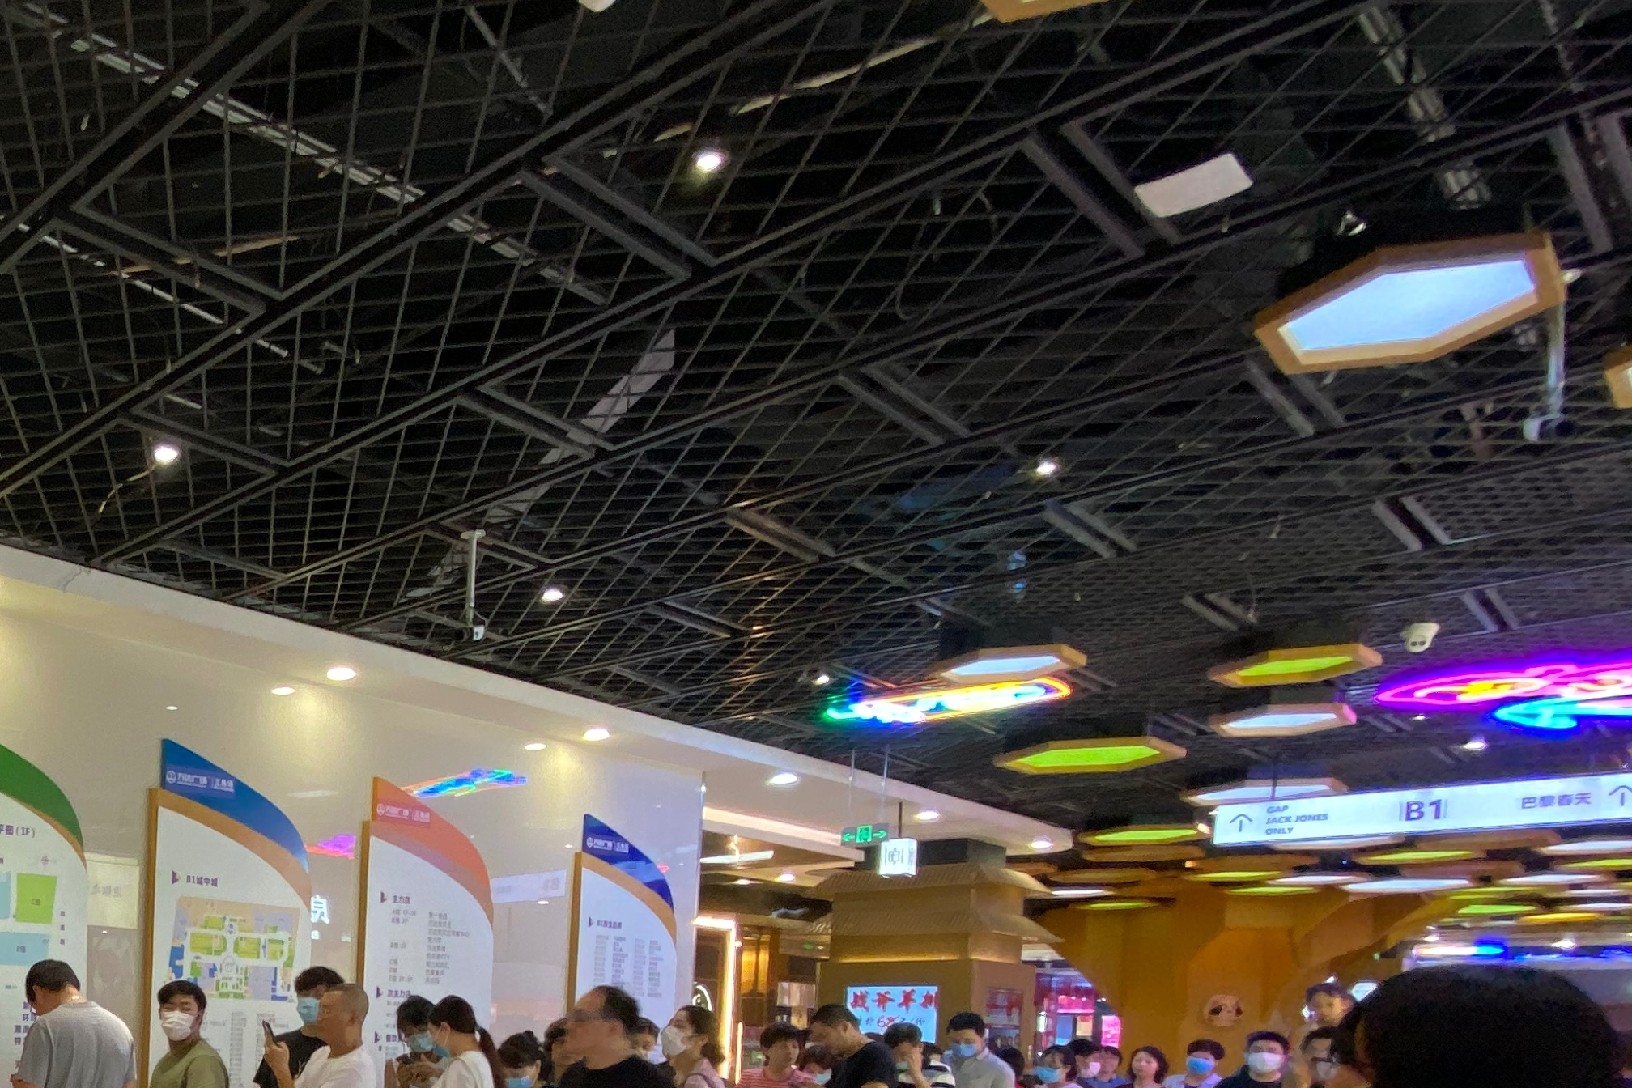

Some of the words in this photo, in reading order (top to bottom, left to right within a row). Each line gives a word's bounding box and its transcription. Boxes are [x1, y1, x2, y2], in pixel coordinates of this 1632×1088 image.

[1267, 804, 1289, 814] GAP
[1405, 799, 1442, 821] B1
[1266, 815, 1291, 825] JACK
[1294, 813, 1328, 823] JONES
[1265, 827, 1294, 836] ONLY
